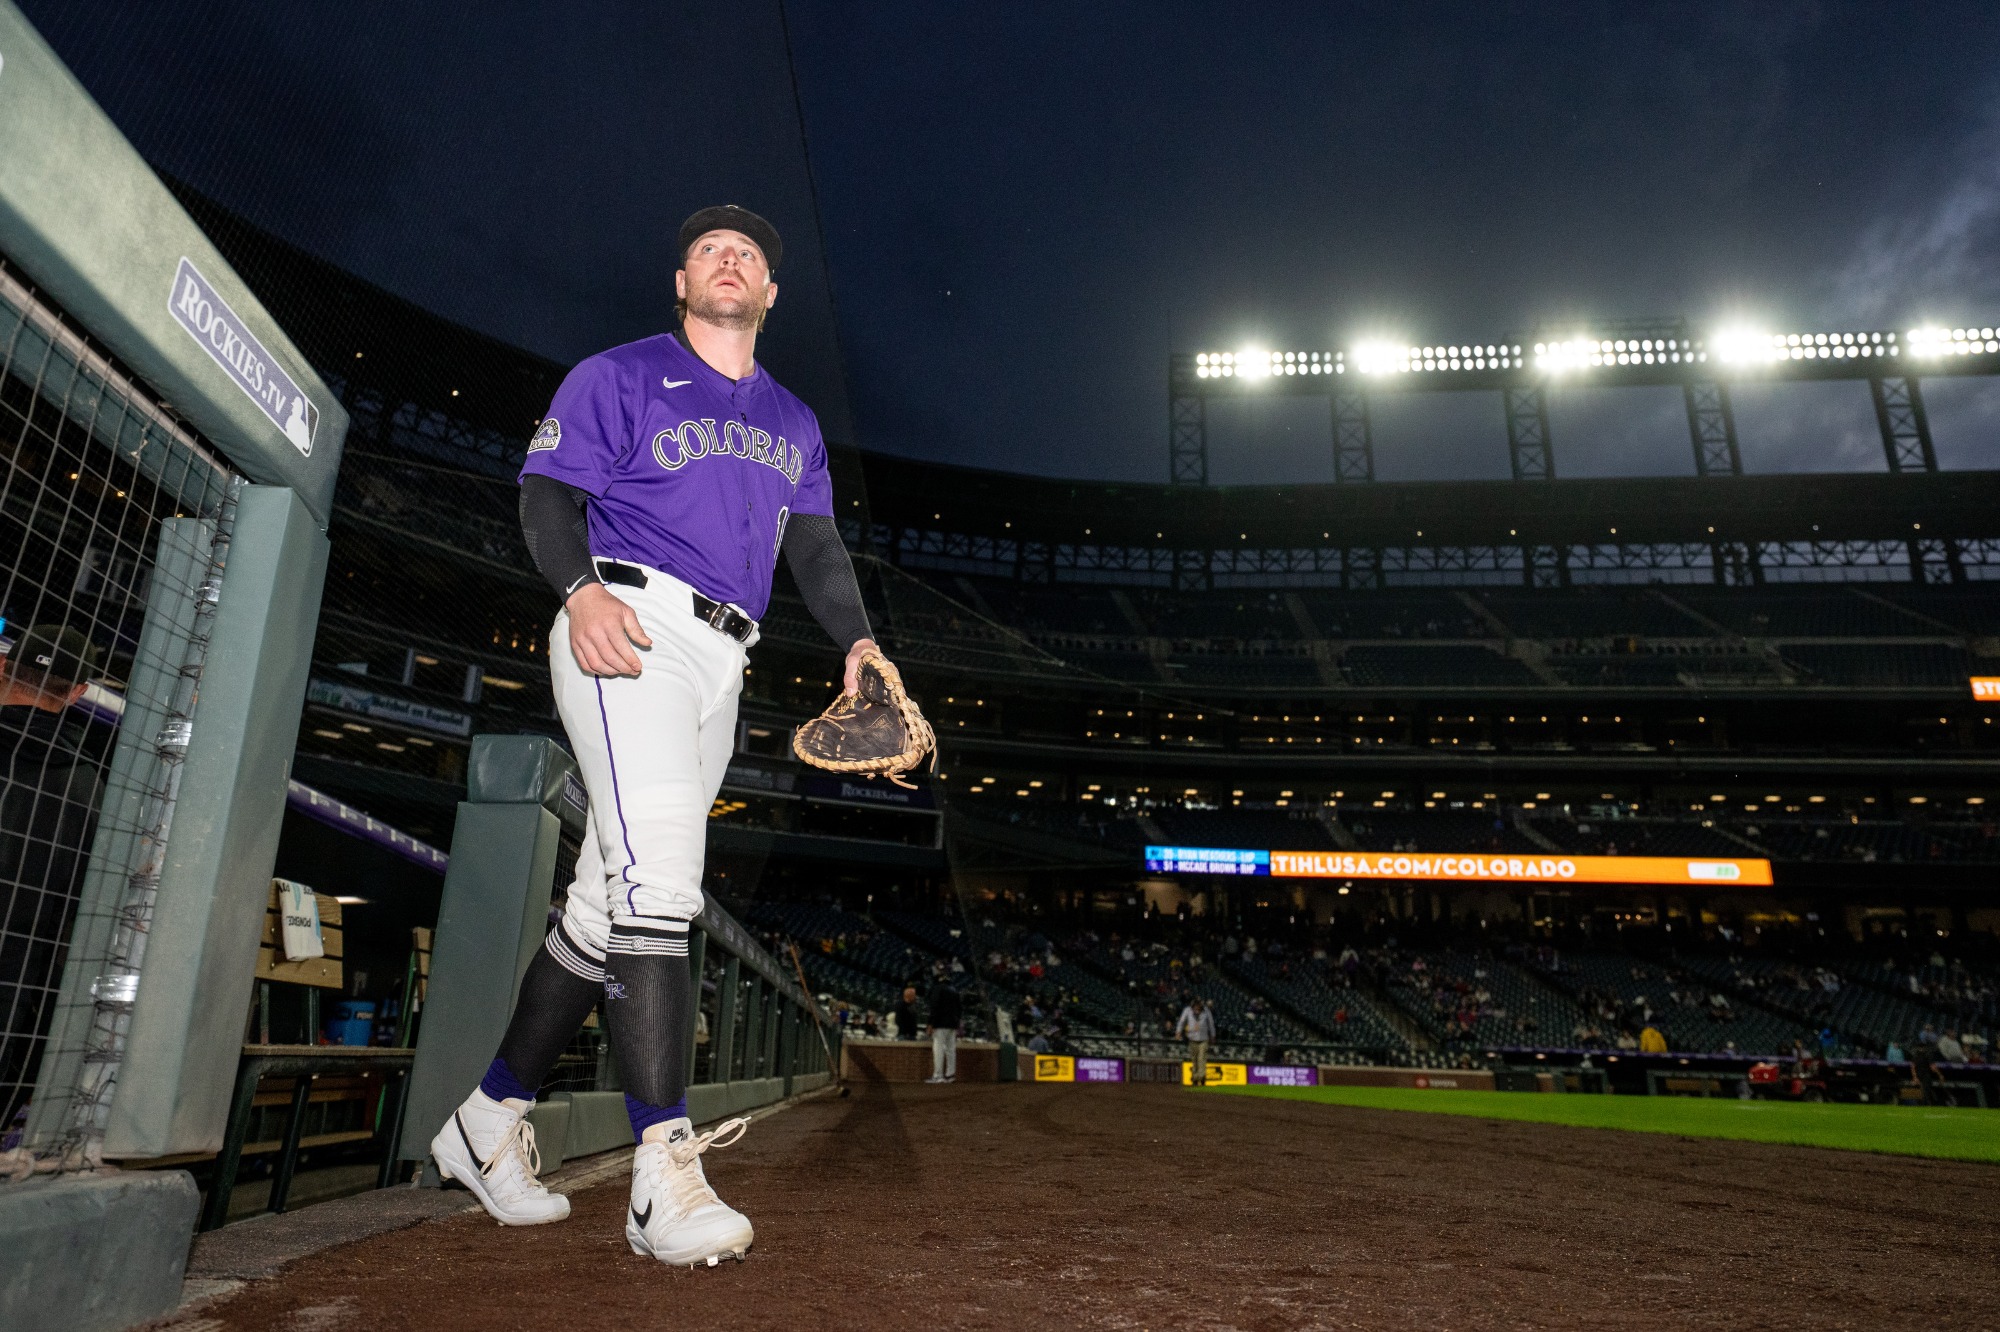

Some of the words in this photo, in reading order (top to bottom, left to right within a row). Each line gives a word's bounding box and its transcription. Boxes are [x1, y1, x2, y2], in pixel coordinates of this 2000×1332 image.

[177, 273, 287, 415] ROCKIES.TV
[652, 418, 804, 485] COLORAD
[1253, 1065, 1296, 1077] CABINETS
[671, 1127, 684, 1138] NIKE
